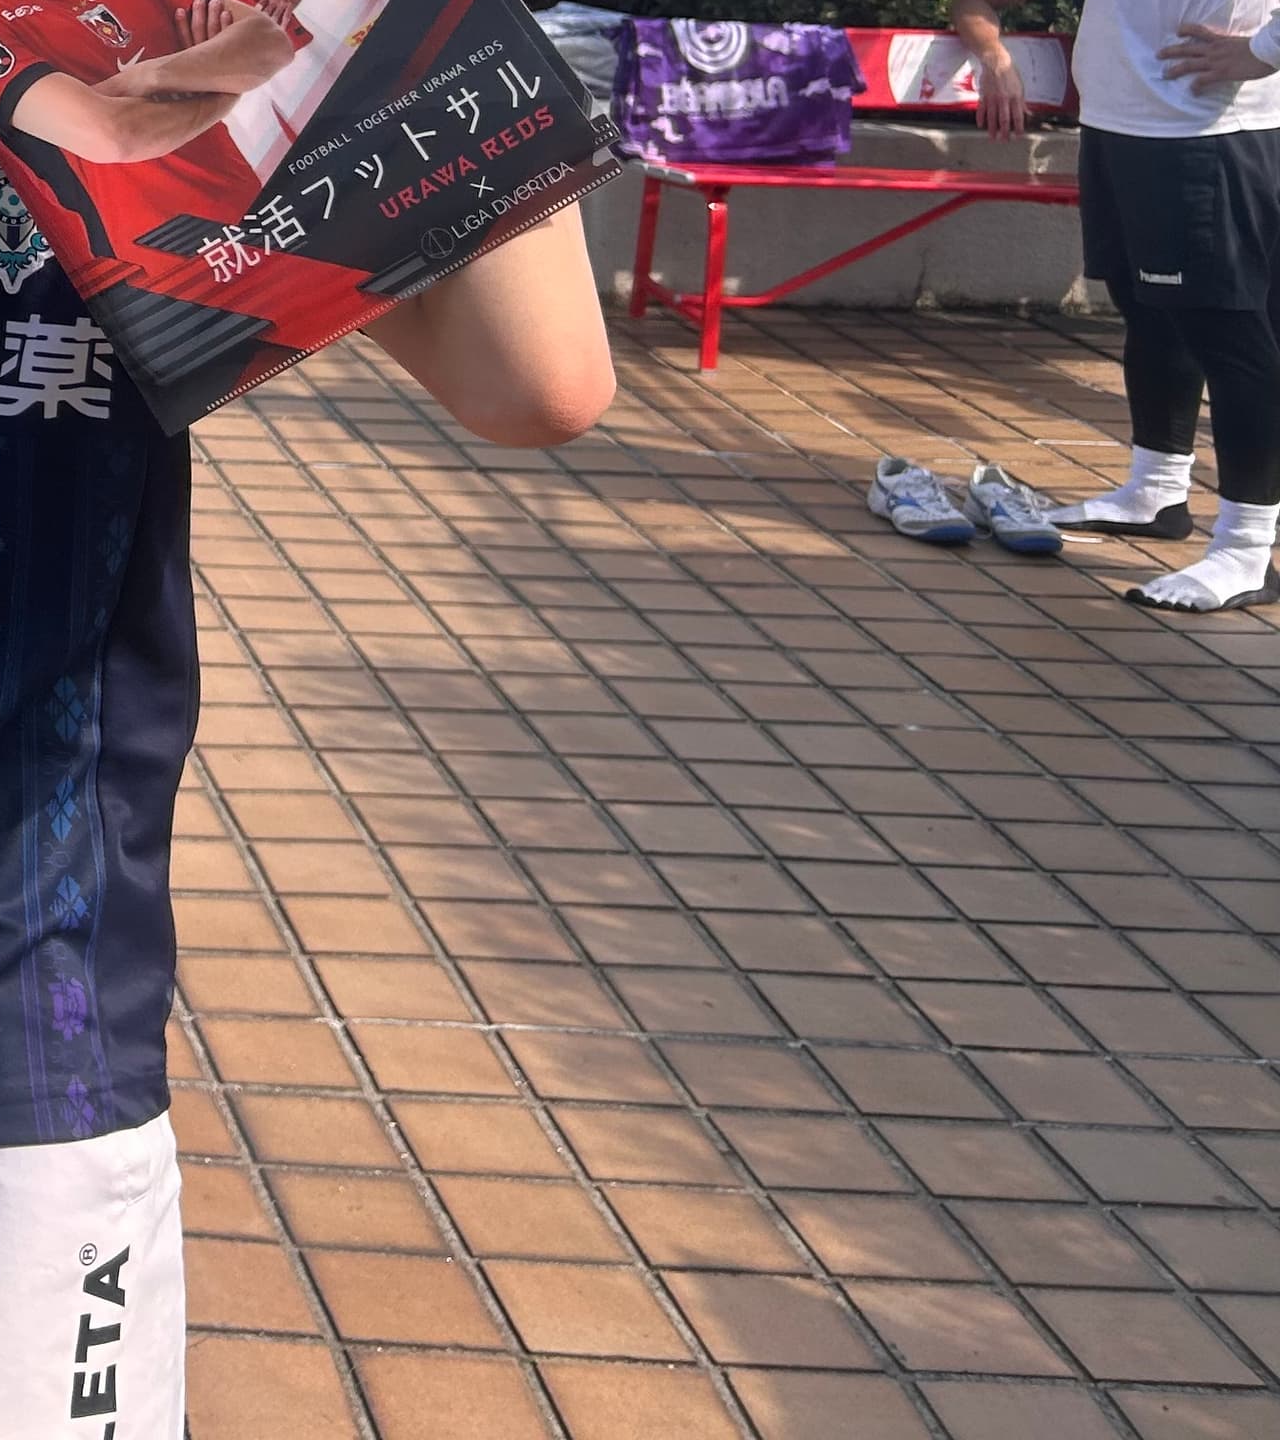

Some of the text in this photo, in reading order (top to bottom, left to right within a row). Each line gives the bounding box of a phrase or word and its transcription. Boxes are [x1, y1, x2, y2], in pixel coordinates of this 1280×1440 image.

[197, 60, 543, 284] 就活フットサル
[288, 39, 504, 176] FOOTBALL TOGETHER URAWA REDS
[378, 105, 555, 220] URAWA REDS
